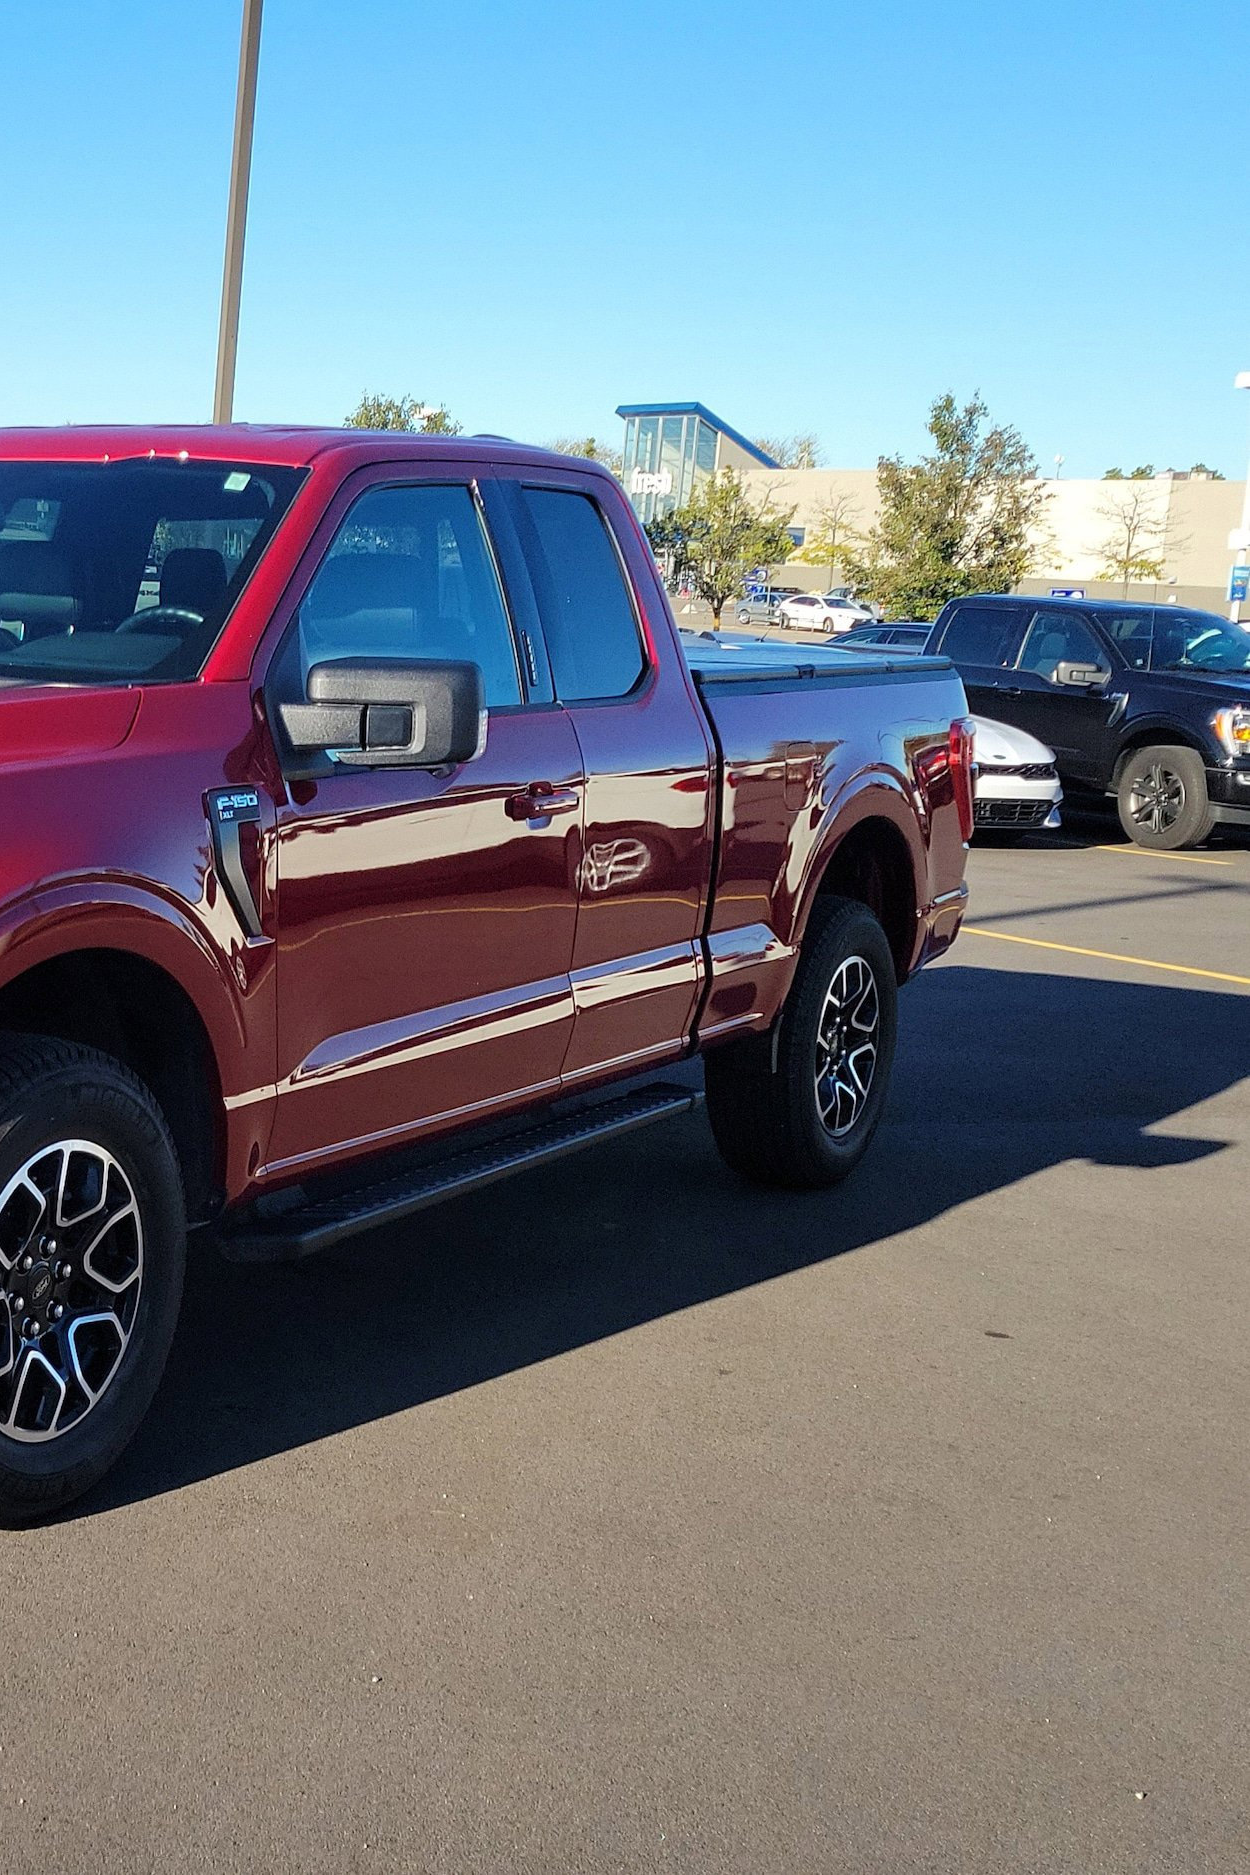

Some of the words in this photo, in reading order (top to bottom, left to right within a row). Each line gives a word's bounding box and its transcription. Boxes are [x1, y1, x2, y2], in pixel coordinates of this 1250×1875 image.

[631, 466, 672, 496] fresh
[217, 793, 258, 810] F-150
[223, 811, 234, 819] XLT
